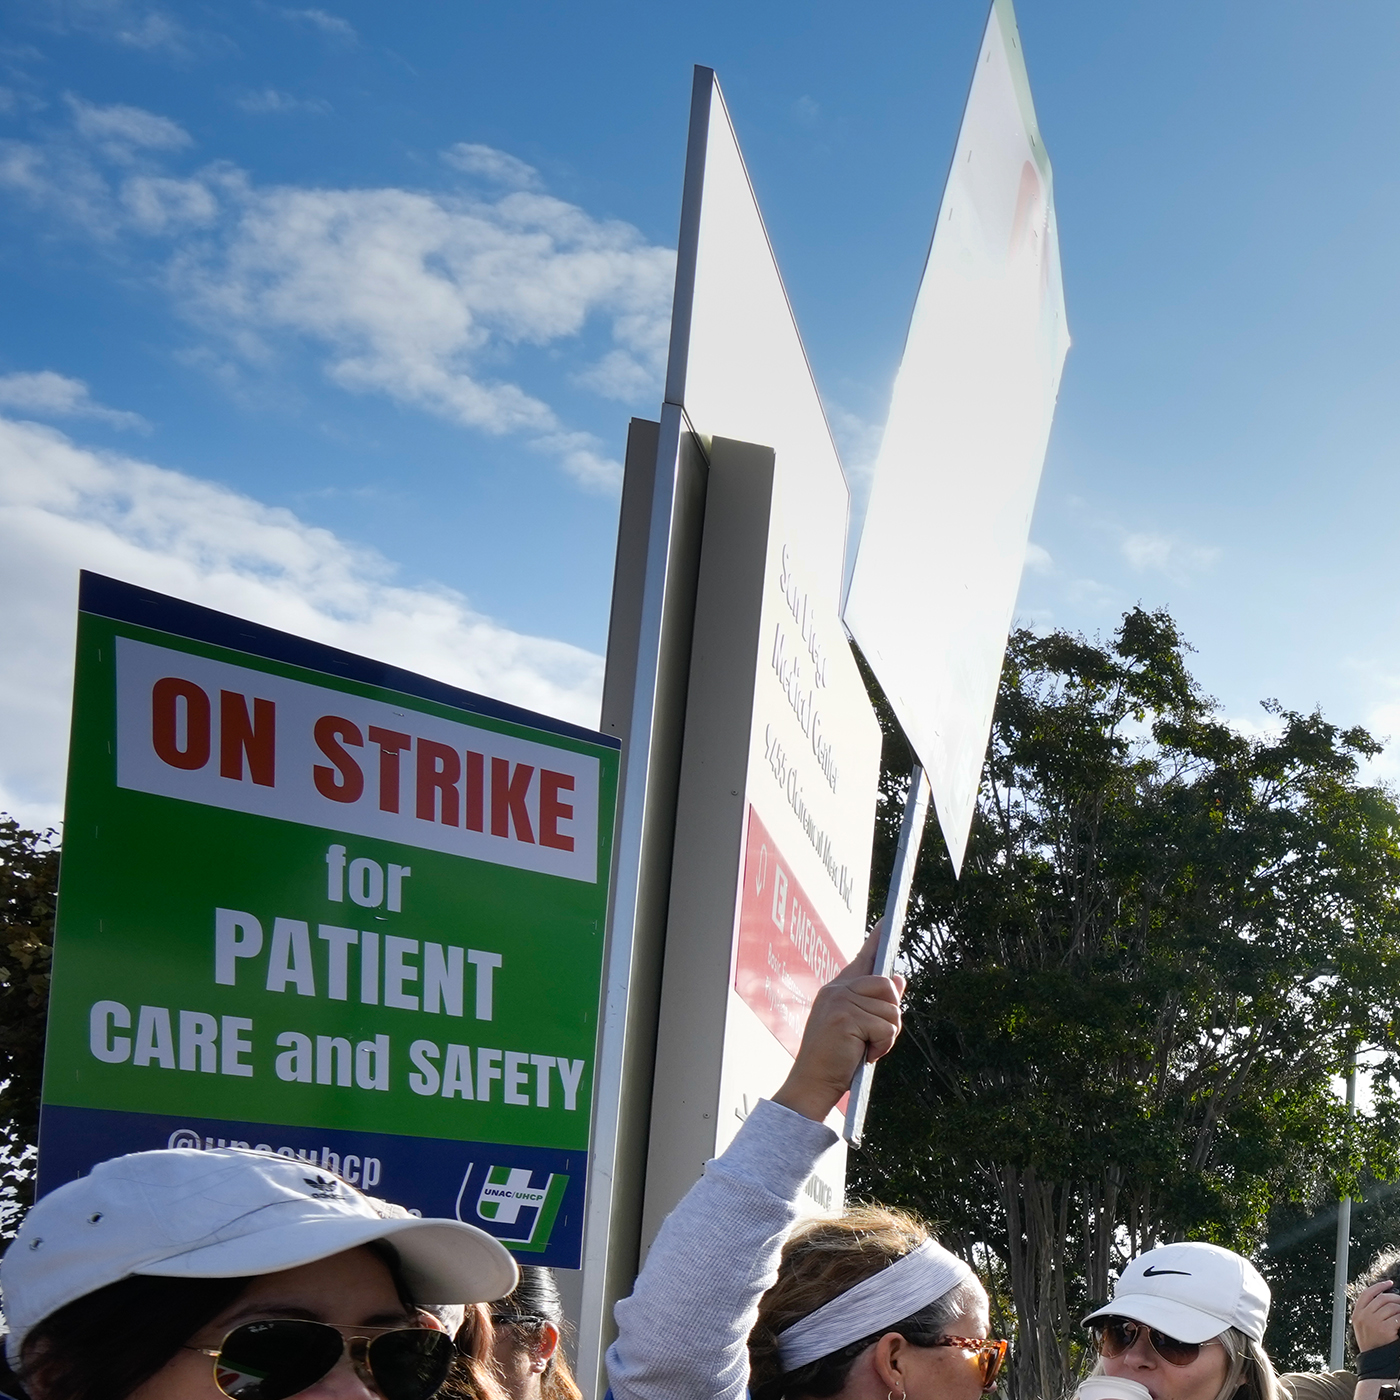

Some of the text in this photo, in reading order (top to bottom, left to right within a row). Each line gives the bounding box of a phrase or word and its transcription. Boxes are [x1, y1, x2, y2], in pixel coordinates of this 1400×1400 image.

[151, 676, 576, 853] ON STRIKE
[325, 843, 411, 914] for
[213, 907, 503, 1023] PATIENT
[789, 896, 841, 986] EMERGENC
[89, 1001, 586, 1112] CARE and SAFETY
[168, 1128, 382, 1190] @uuhcp
[483, 1187, 544, 1203] UNAC/UHCP
